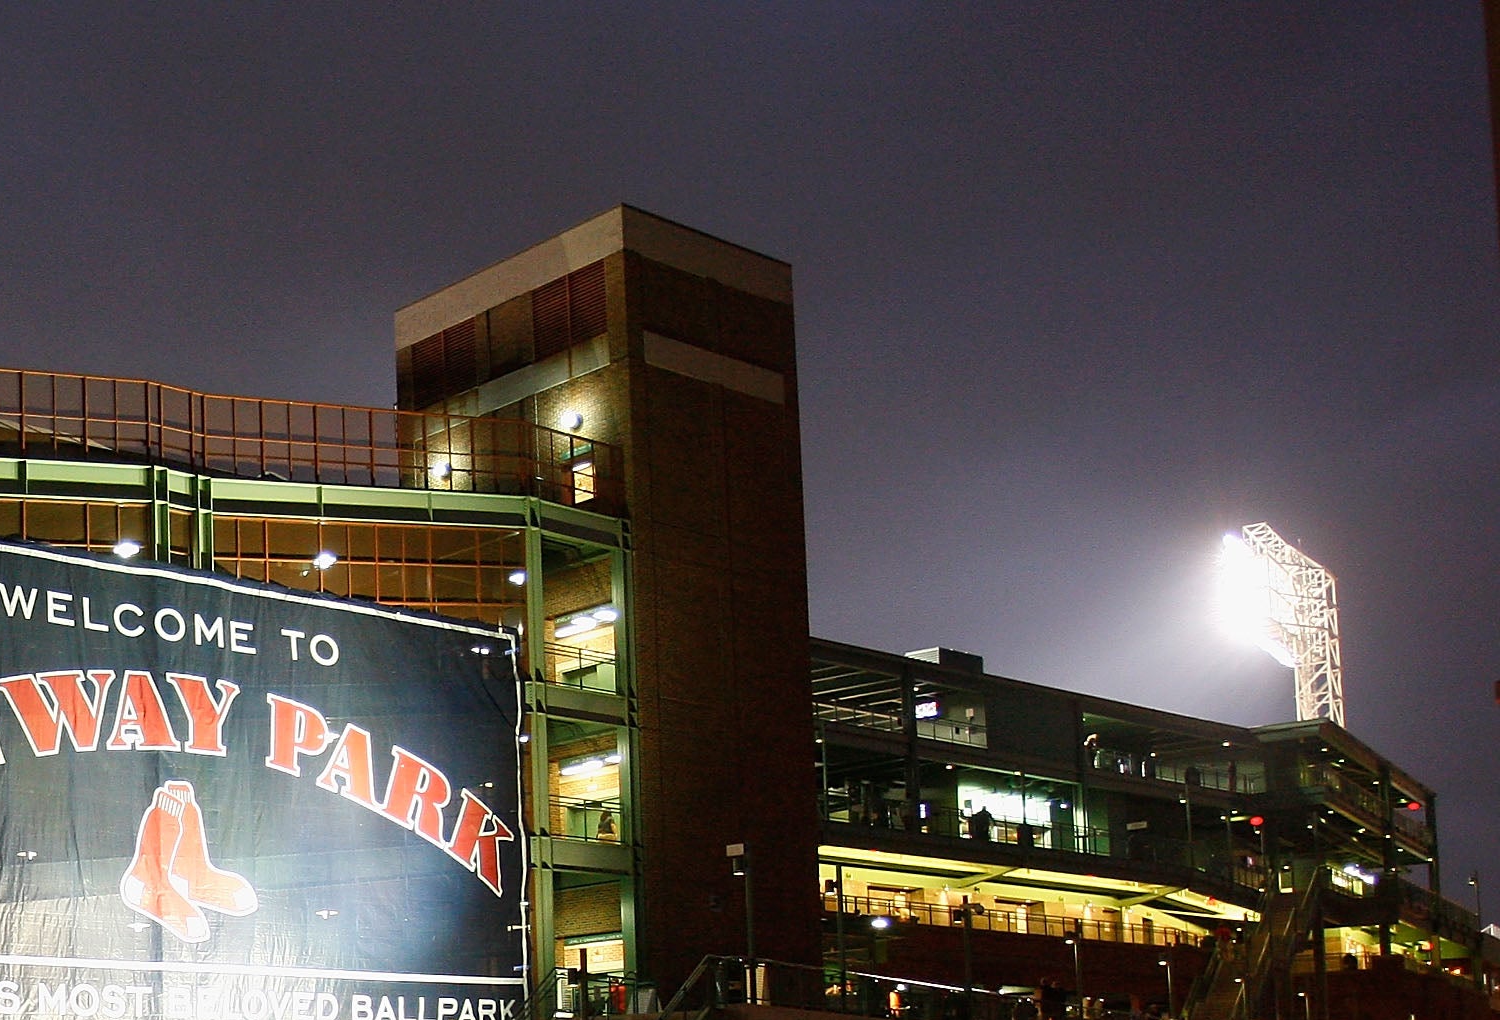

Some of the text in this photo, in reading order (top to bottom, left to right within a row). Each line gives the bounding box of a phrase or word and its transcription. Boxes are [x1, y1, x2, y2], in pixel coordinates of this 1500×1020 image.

[281, 628, 340, 667] TO
[266, 692, 515, 898] PARK
[38, 982, 146, 1015] MOST
